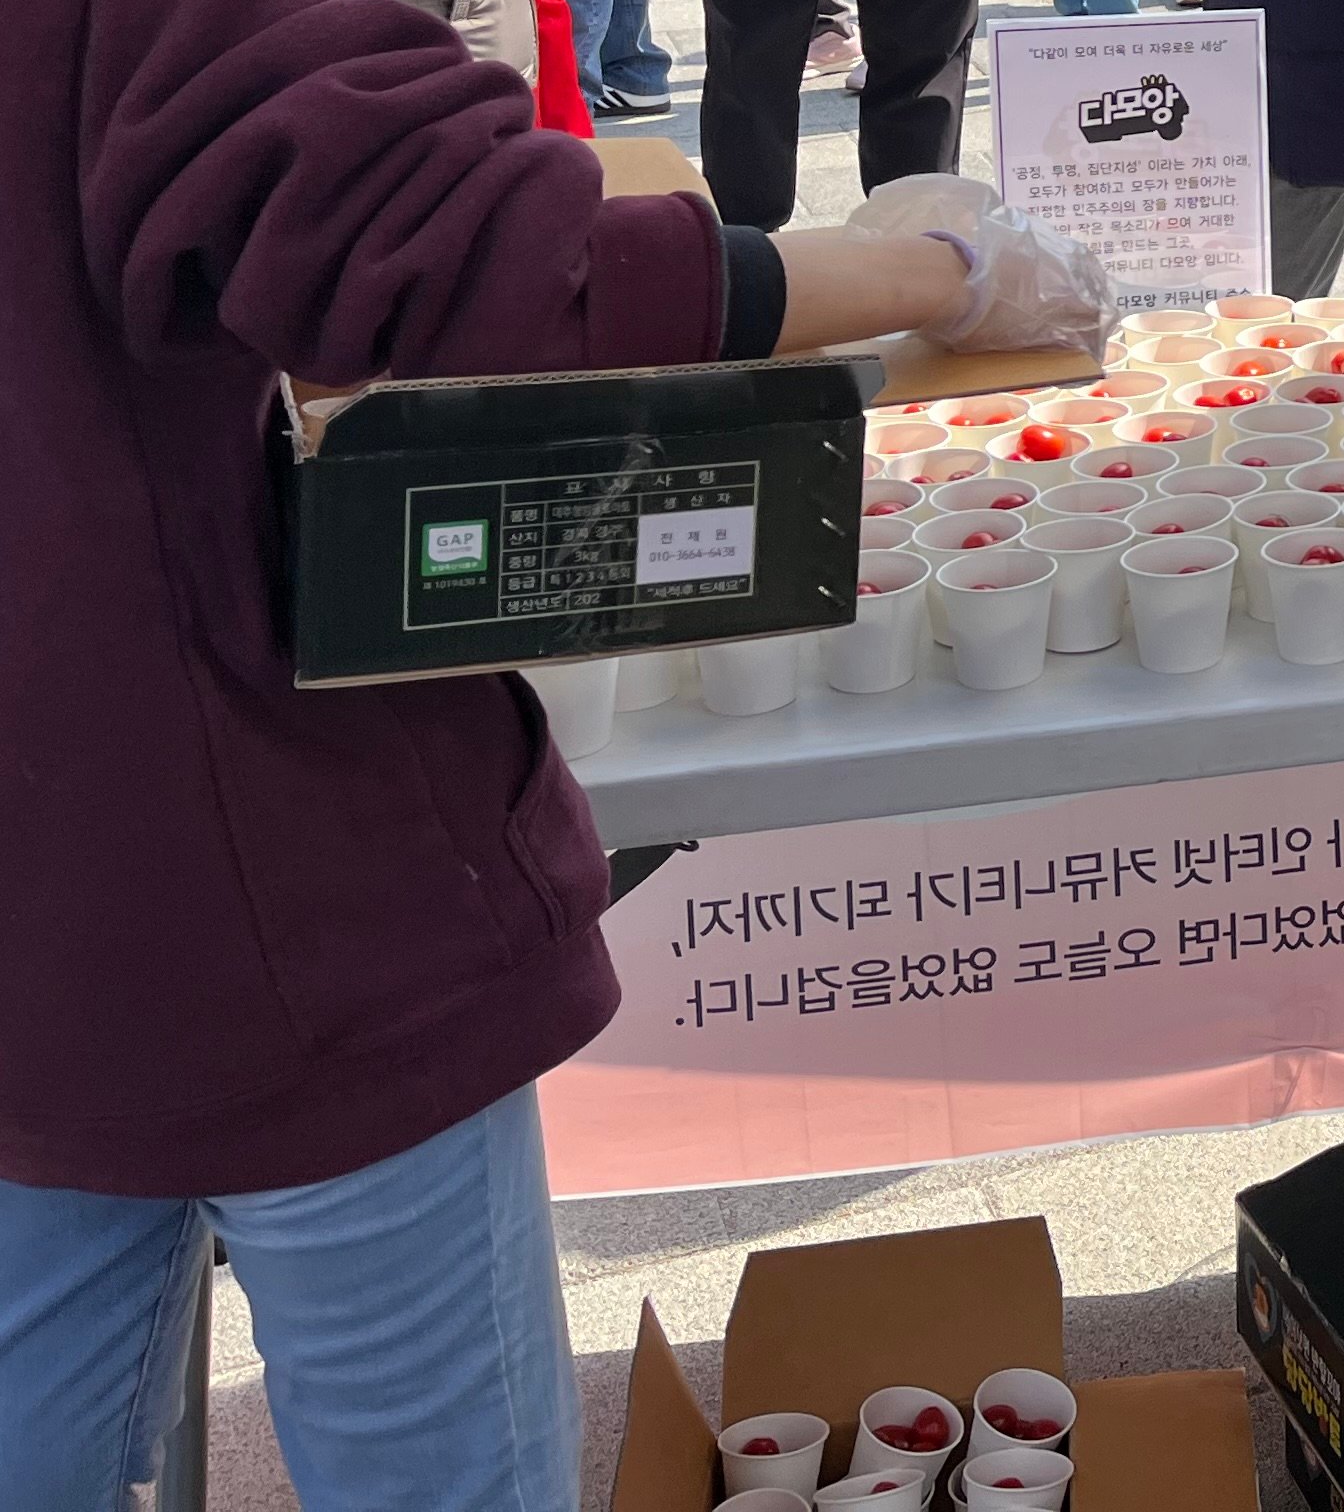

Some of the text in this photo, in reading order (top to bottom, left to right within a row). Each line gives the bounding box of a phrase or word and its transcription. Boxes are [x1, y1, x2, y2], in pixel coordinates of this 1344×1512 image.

[1074, 45, 1098, 58] 모여
[1132, 44, 1145, 55] 더
[1149, 41, 1195, 55] 자유로운
[1077, 80, 1184, 129] 다모앙
[1053, 163, 1081, 178] 투명,
[1148, 158, 1186, 172] 이라는
[1191, 155, 1218, 170] 가치
[1223, 154, 1251, 168] 아래,
[1028, 175, 1238, 199] 모두가 참여하고 모두가 만들어가는
[1073, 199, 1136, 217] 민주주의의
[1142, 198, 1167, 212] 장을
[1174, 194, 1240, 210] 지향합니다.
[1078, 221, 1104, 236] 작은
[1110, 218, 1160, 234] 목소리가
[1199, 213, 1236, 228] 거대한
[1104, 251, 1245, 273] 커뮤니티 다모앙 입니다.
[1116, 294, 1158, 310] 다모앙
[1164, 288, 1218, 306] 커뮤니티
[436, 532, 475, 548] GAP
[509, 531, 538, 546] 산지
[508, 550, 600, 569] 중량 3kg
[507, 576, 536, 590] 등급
